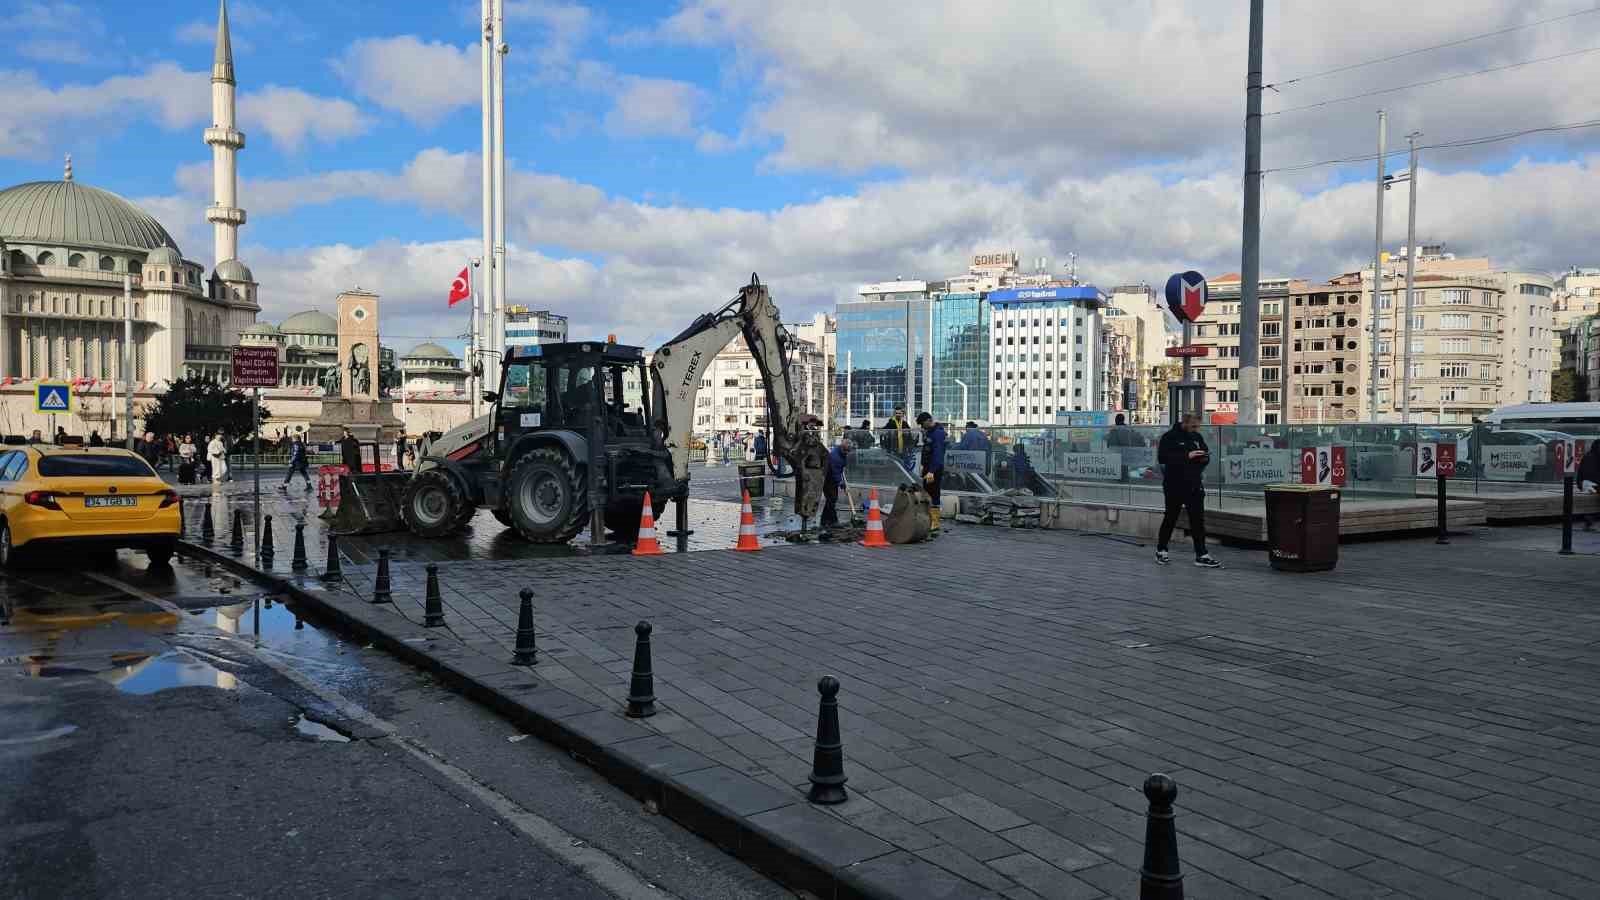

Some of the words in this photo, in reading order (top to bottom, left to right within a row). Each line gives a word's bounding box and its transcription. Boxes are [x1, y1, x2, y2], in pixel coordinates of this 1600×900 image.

[235, 359, 253, 367] Mobil
[242, 367, 269, 375] Denetim
[682, 351, 701, 386] TEREX
[1079, 456, 1107, 464] METRO
[1243, 458, 1272, 468] METRO
